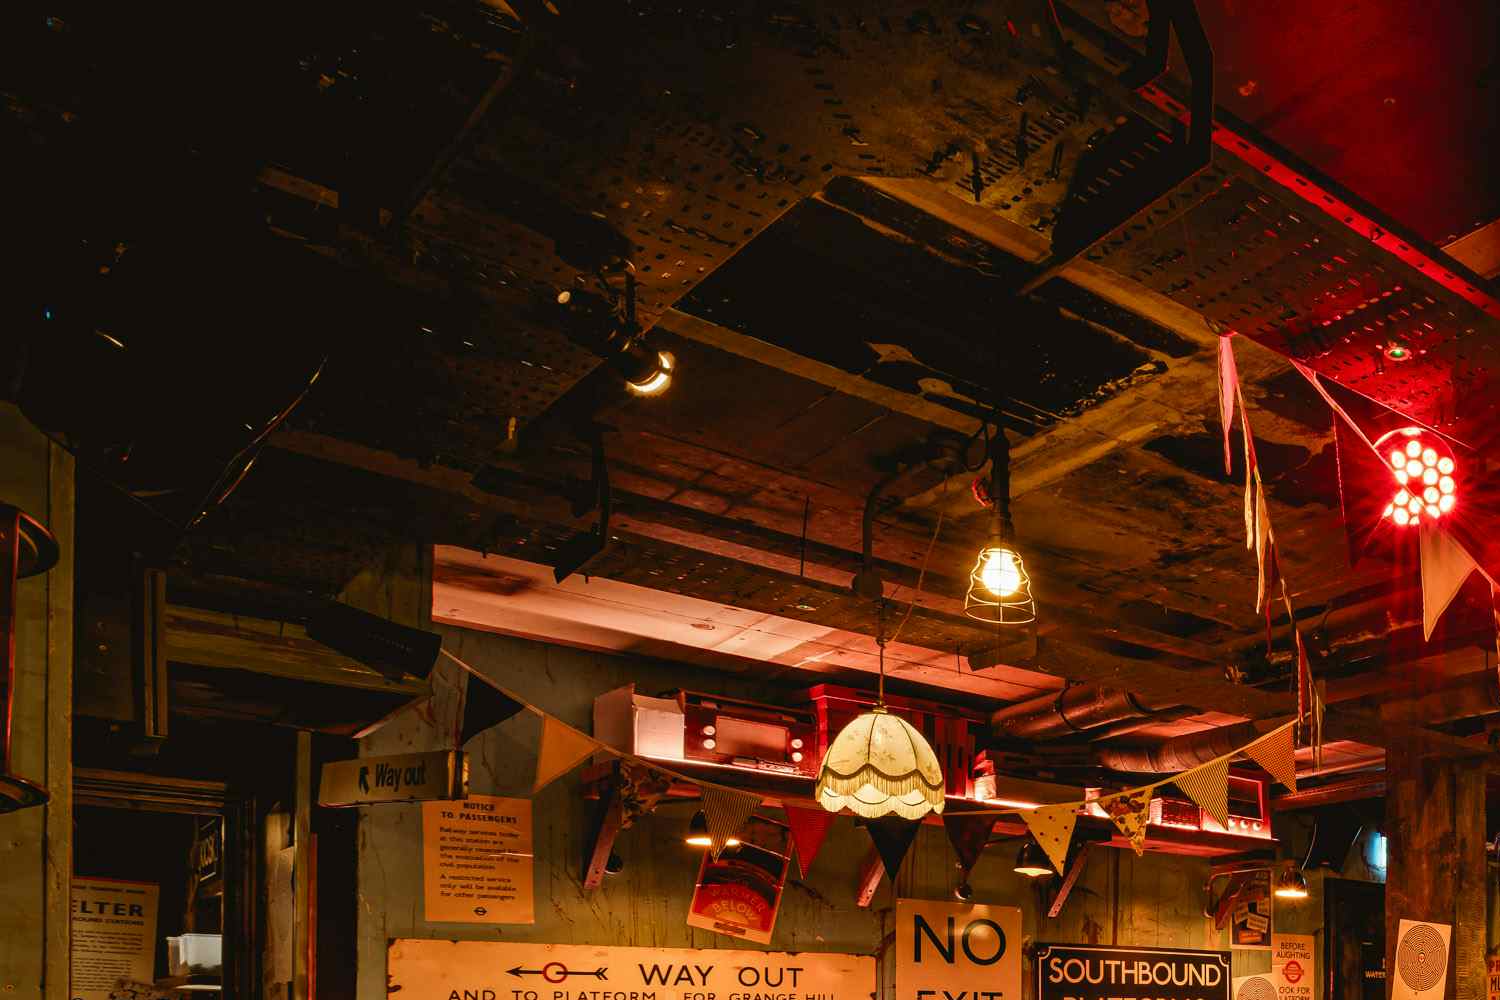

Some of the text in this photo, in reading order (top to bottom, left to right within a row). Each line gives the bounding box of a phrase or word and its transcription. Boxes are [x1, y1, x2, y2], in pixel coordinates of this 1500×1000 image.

[375, 759, 426, 792] Way out
[463, 802, 496, 811] NOTICE
[441, 811, 518, 824] TO PASSENGERS
[711, 900, 756, 920] BELOW
[913, 913, 1007, 966] NO
[1280, 942, 1305, 951] BEFORE
[1276, 951, 1311, 960] ALIGHTING
[638, 963, 804, 988] WAY OUT
[1048, 957, 1221, 987] SOUTHBOUND
